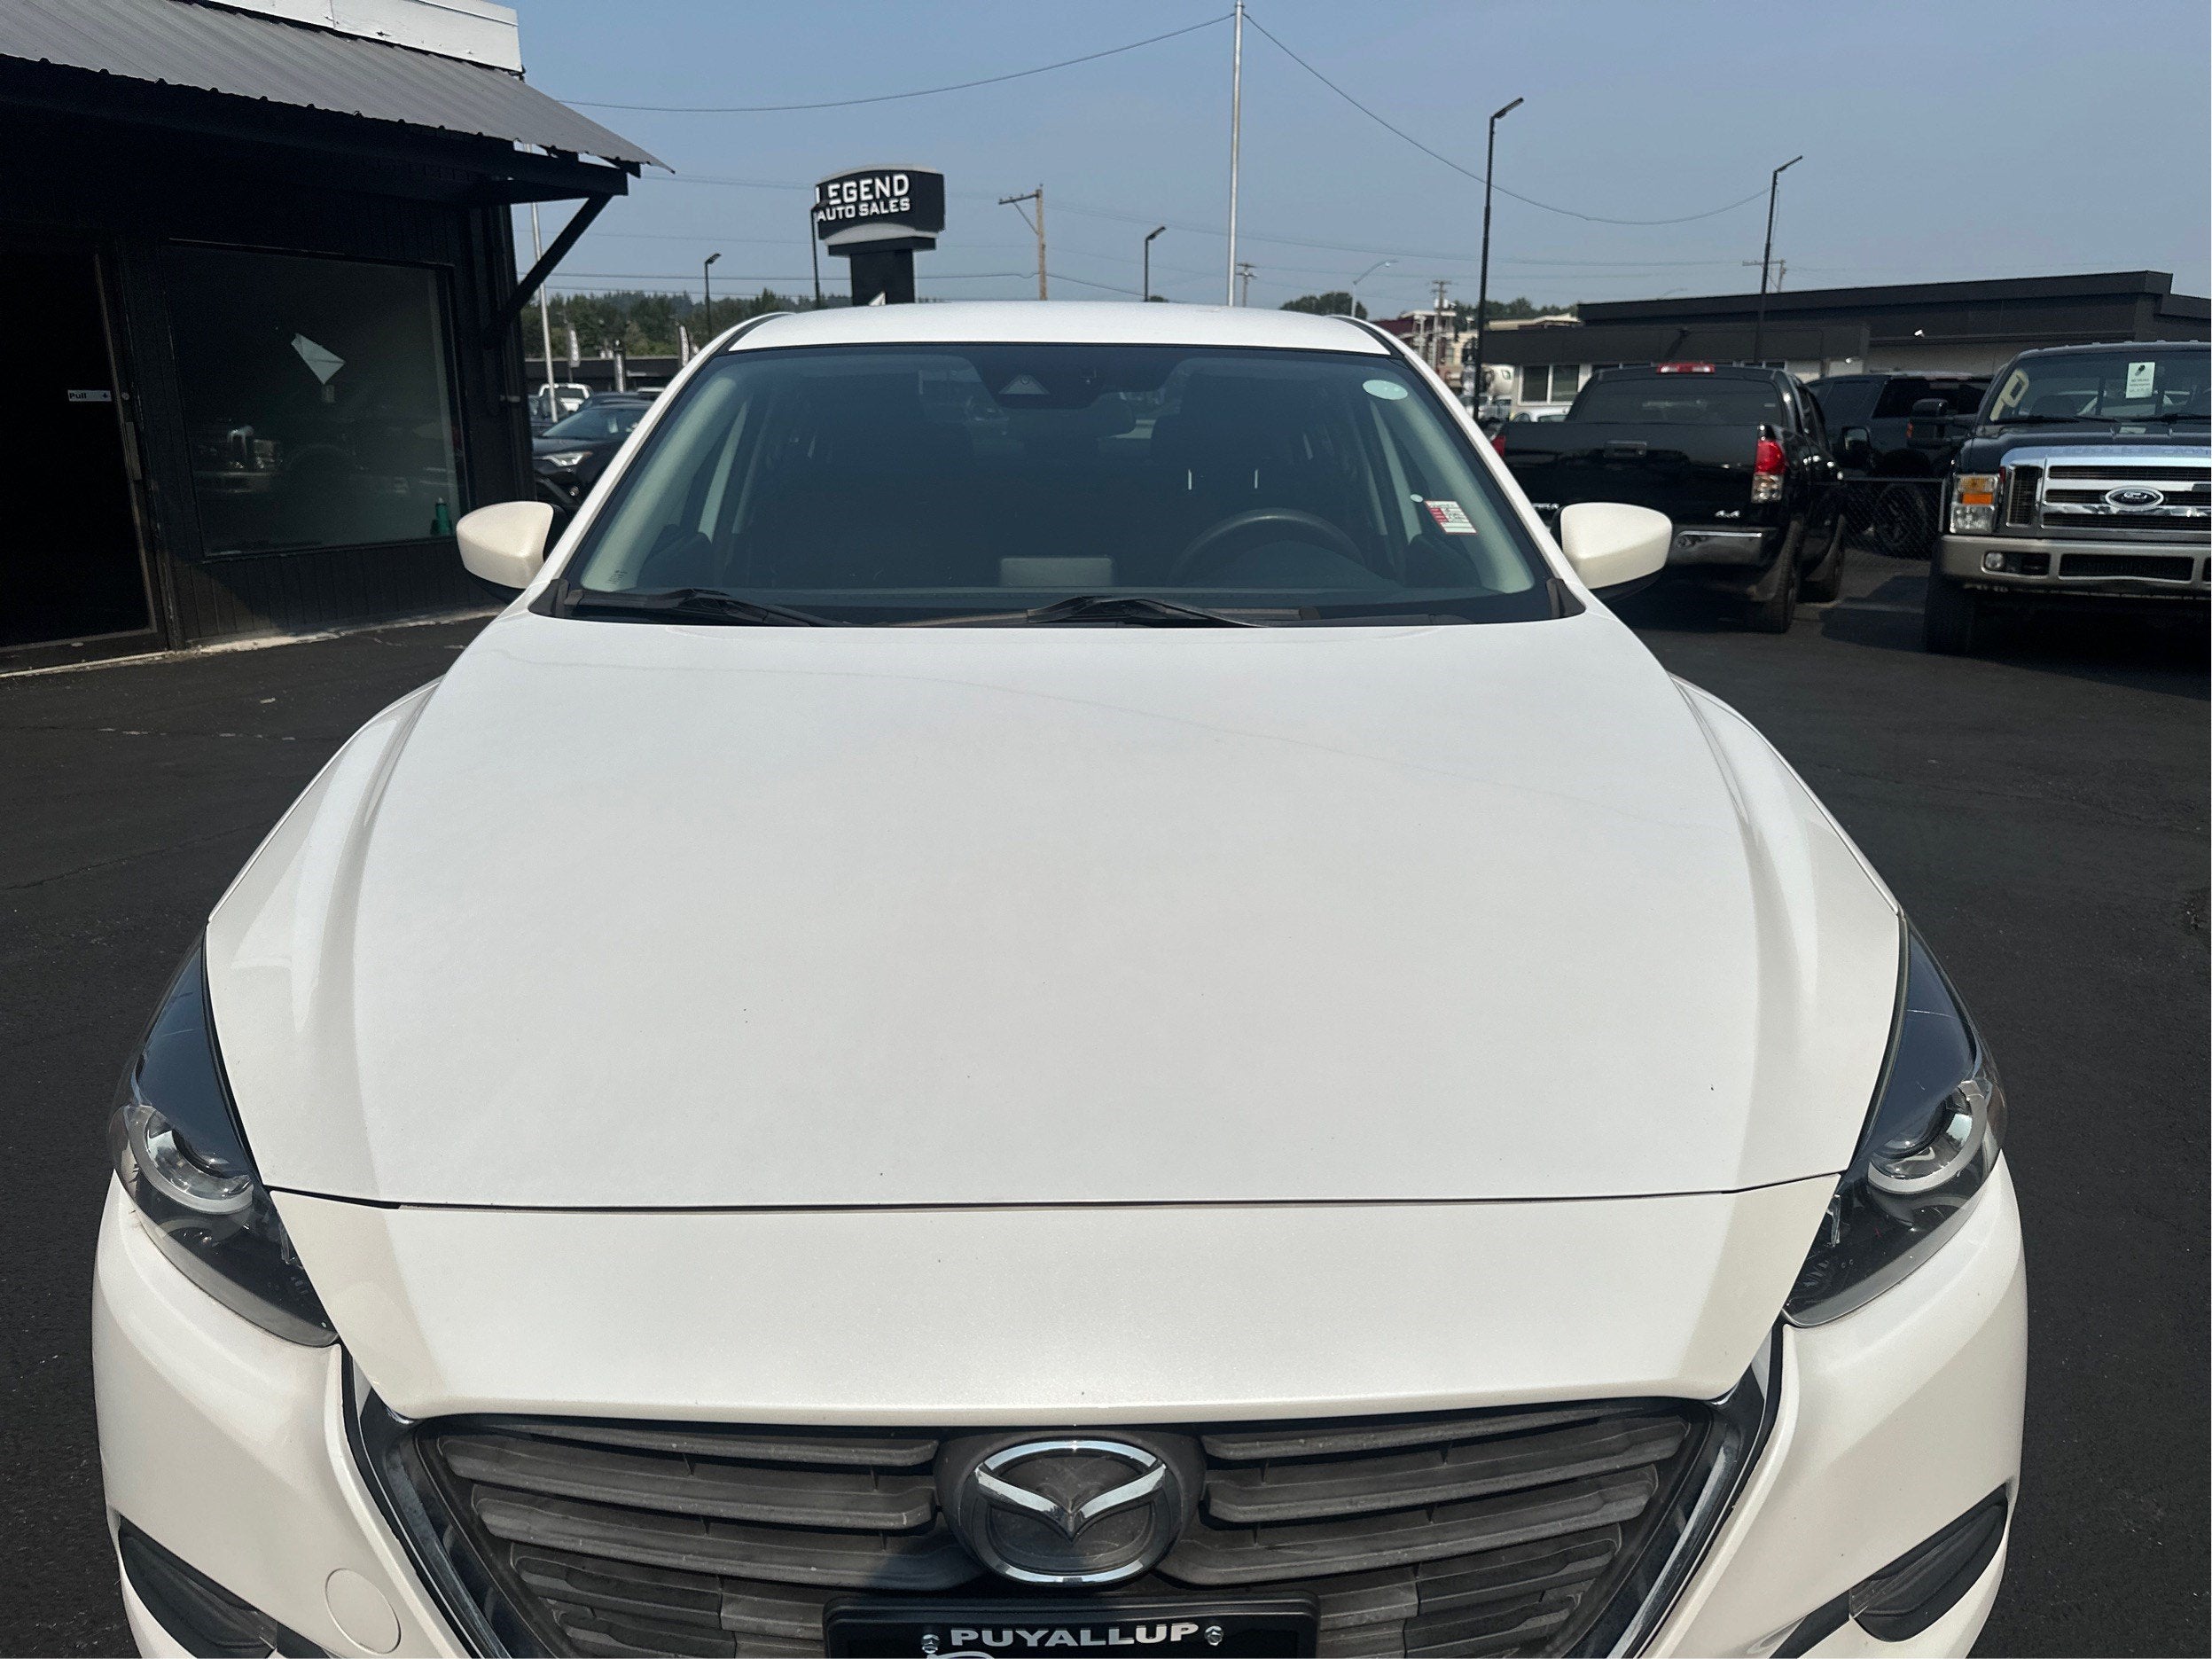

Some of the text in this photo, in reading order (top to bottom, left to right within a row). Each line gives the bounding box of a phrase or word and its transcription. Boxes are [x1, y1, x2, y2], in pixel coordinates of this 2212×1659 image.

[816, 197, 911, 222] AUTO SALES
[950, 1622, 1199, 1647] PUYALLUP
